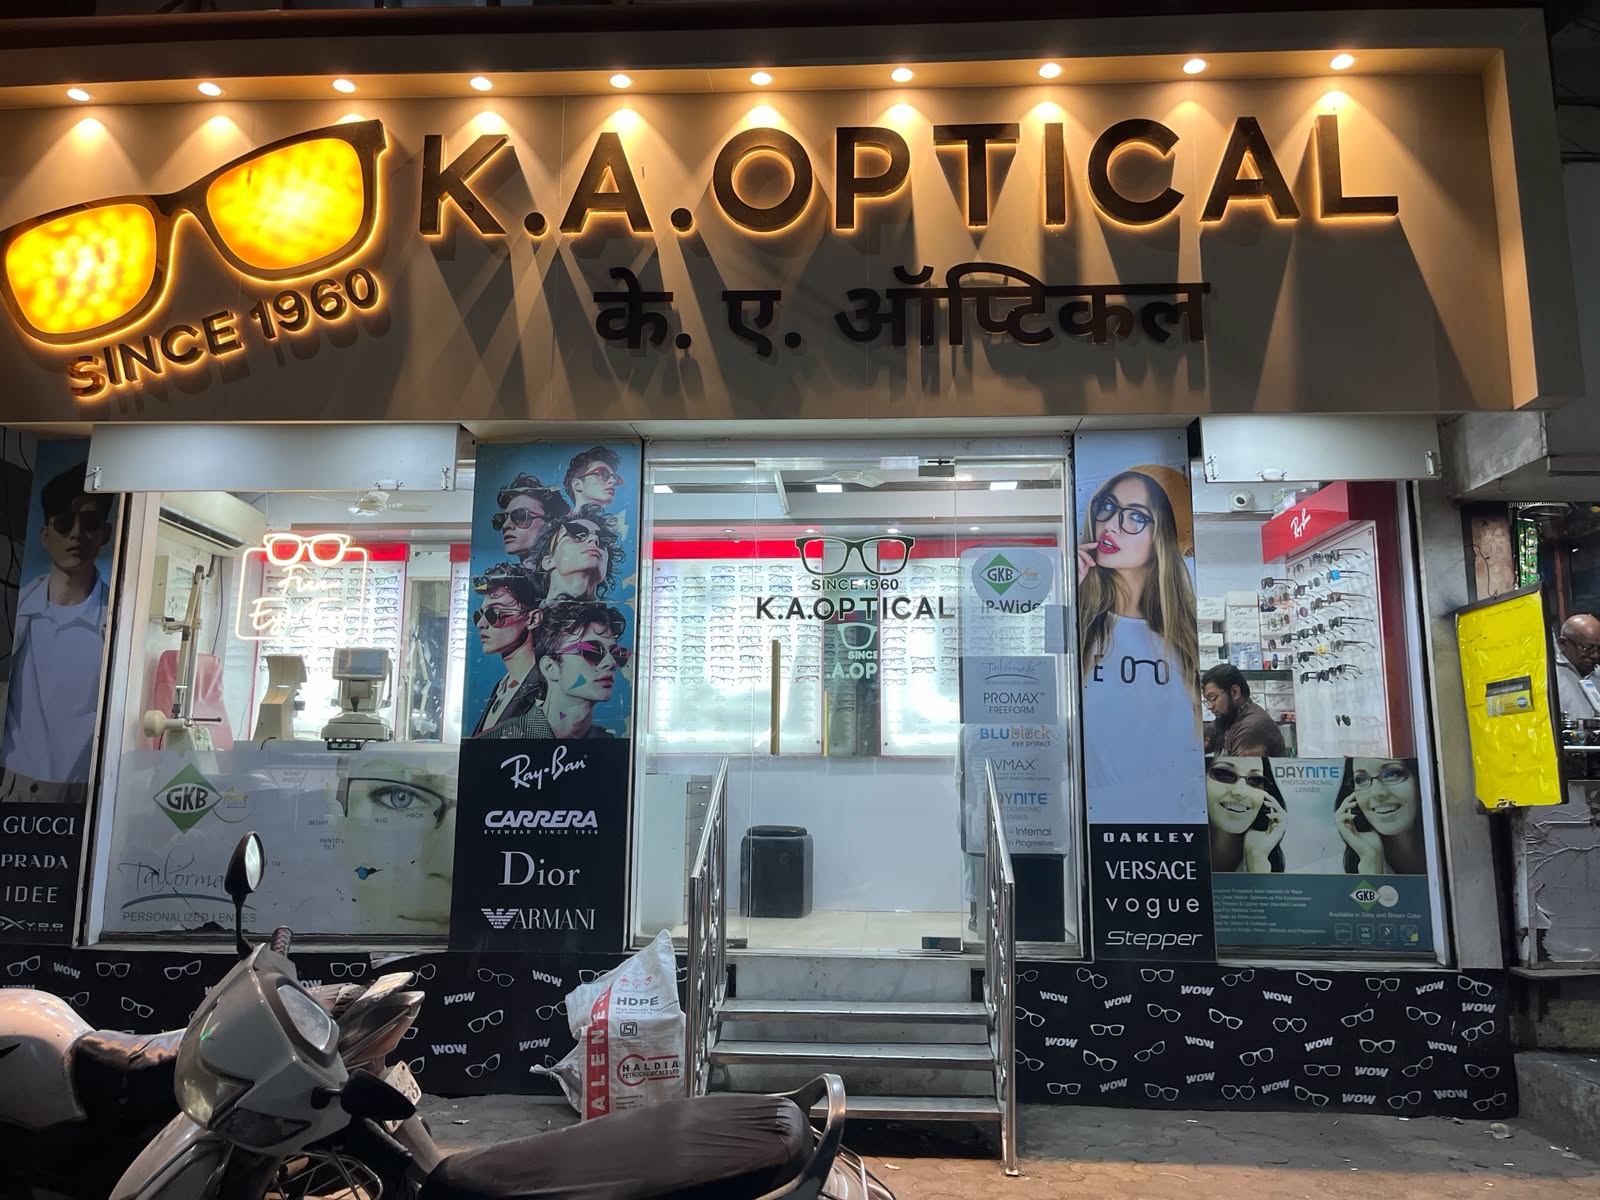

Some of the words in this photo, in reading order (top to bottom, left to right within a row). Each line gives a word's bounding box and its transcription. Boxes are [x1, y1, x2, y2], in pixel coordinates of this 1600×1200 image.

[419, 114, 1399, 239] K.A.OPTICAL
[593, 266, 692, 350] के.
[722, 289, 802, 357] ए.
[833, 261, 1211, 348] ऑप्टिकल
[67, 310, 243, 401] SINCE
[250, 268, 380, 341] 1960
[987, 567, 1014, 582] GKB
[811, 578, 858, 591] SINCE
[863, 578, 899, 591] 1960
[756, 595, 956, 621] K.A.OPTICAL
[847, 650, 878, 660] SINCE
[988, 705, 1035, 715] FREEFORM
[1274, 766, 1340, 779] DAYNITE
[165, 786, 209, 811] GKB
[3, 815, 76, 836] GUCCI
[484, 810, 598, 828] CARRERA
[1015, 827, 1052, 837] Internal
[1103, 832, 1195, 843] OAKLEY
[0, 853, 69, 869] PRADA
[497, 850, 581, 886] Dior
[1105, 860, 1198, 880] VERSACE
[5, 885, 59, 904] IDEE
[1355, 890, 1376, 902] GKB
[1105, 897, 1200, 919] vogue
[123, 911, 209, 923] PERSONALIZED
[212, 912, 257, 923] LENES
[511, 908, 596, 930] ARMANI
[1105, 930, 1204, 950] Stepper
[53, 961, 81, 980] WOW
[532, 969, 563, 988] WOW
[1180, 984, 1215, 997] WOW
[1415, 980, 1445, 996] WOW
[443, 991, 476, 1006] WOW
[616, 995, 660, 1007] HDPE
[1039, 990, 1069, 1004] WOW
[1104, 994, 1133, 1009] WOW
[1262, 989, 1293, 1005] WOW
[1461, 1001, 1497, 1014] WOW
[431, 1043, 468, 1056] WOW
[518, 1037, 551, 1052] WOW
[1044, 1036, 1079, 1049] WOW
[1184, 1034, 1216, 1050] WOW
[1304, 1036, 1335, 1052] WOW
[1426, 1040, 1458, 1054] WOW
[622, 1061, 680, 1073] HALDIA
[1354, 1065, 1389, 1078] WOW
[1099, 1078, 1129, 1093] WOW
[1186, 1071, 1216, 1085] WOW
[1261, 1079, 1291, 1094] WOW
[1341, 1093, 1377, 1105] WOW
[1433, 1089, 1469, 1100] WOW
